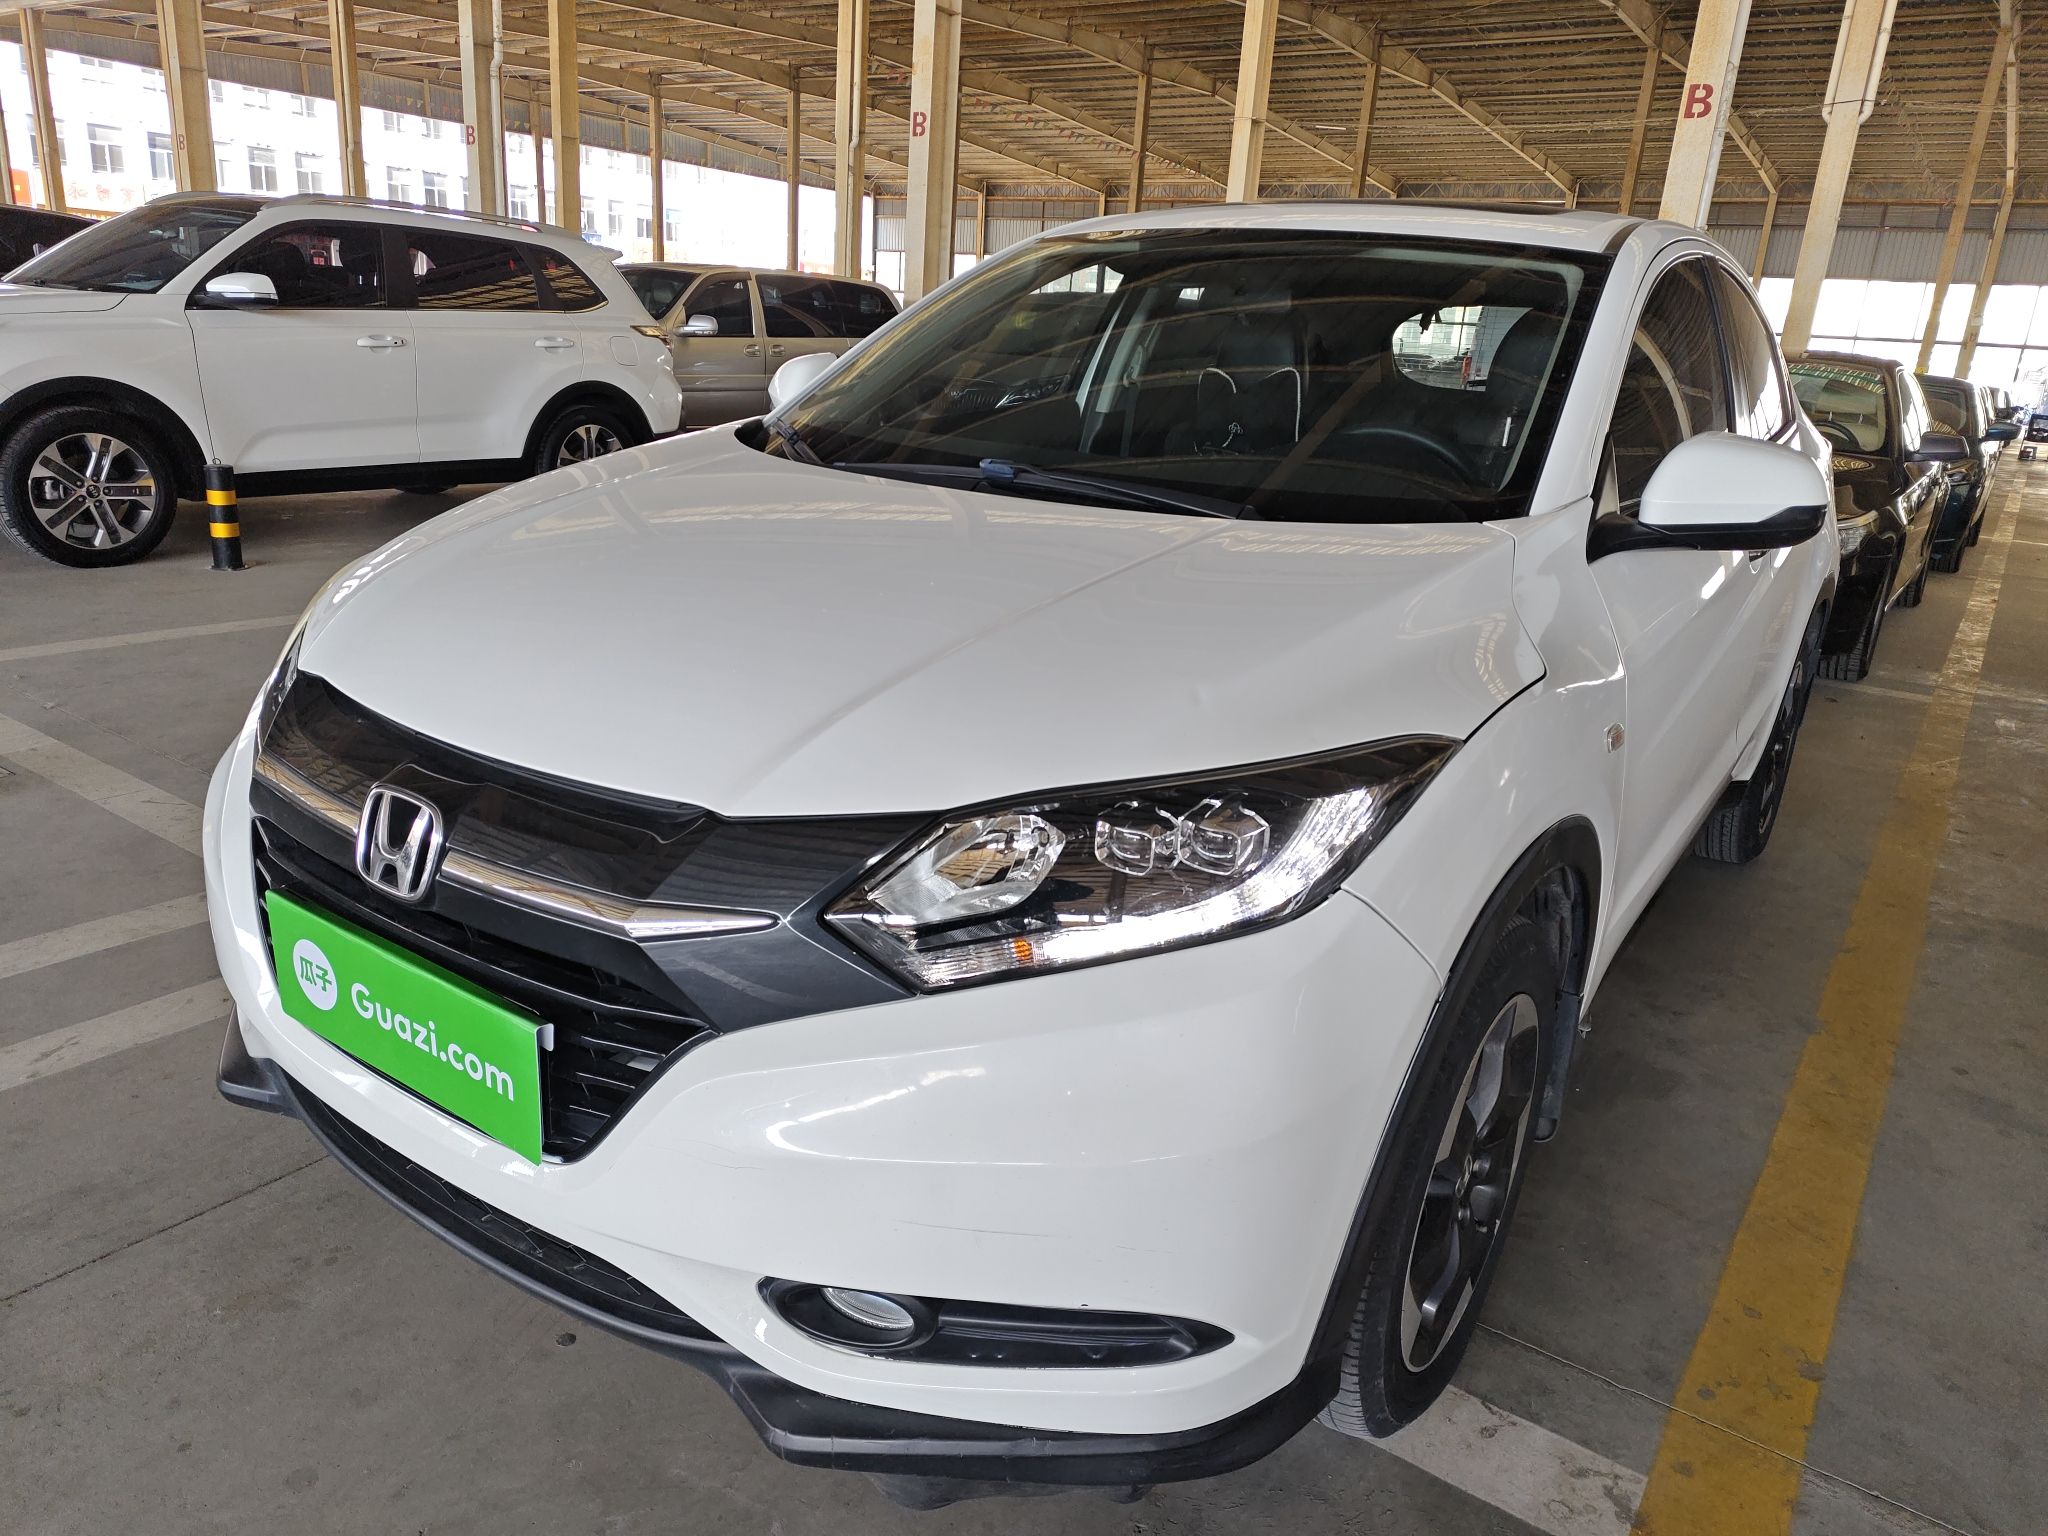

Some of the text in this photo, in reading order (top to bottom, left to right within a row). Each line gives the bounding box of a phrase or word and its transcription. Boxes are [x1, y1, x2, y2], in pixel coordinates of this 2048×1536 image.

[1683, 83, 1713, 119] B
[465, 124, 476, 146] B
[912, 111, 927, 137] B
[178, 133, 186, 151] B
[299, 956, 333, 992] 瓜子
[350, 982, 515, 1102] Guazi.com
